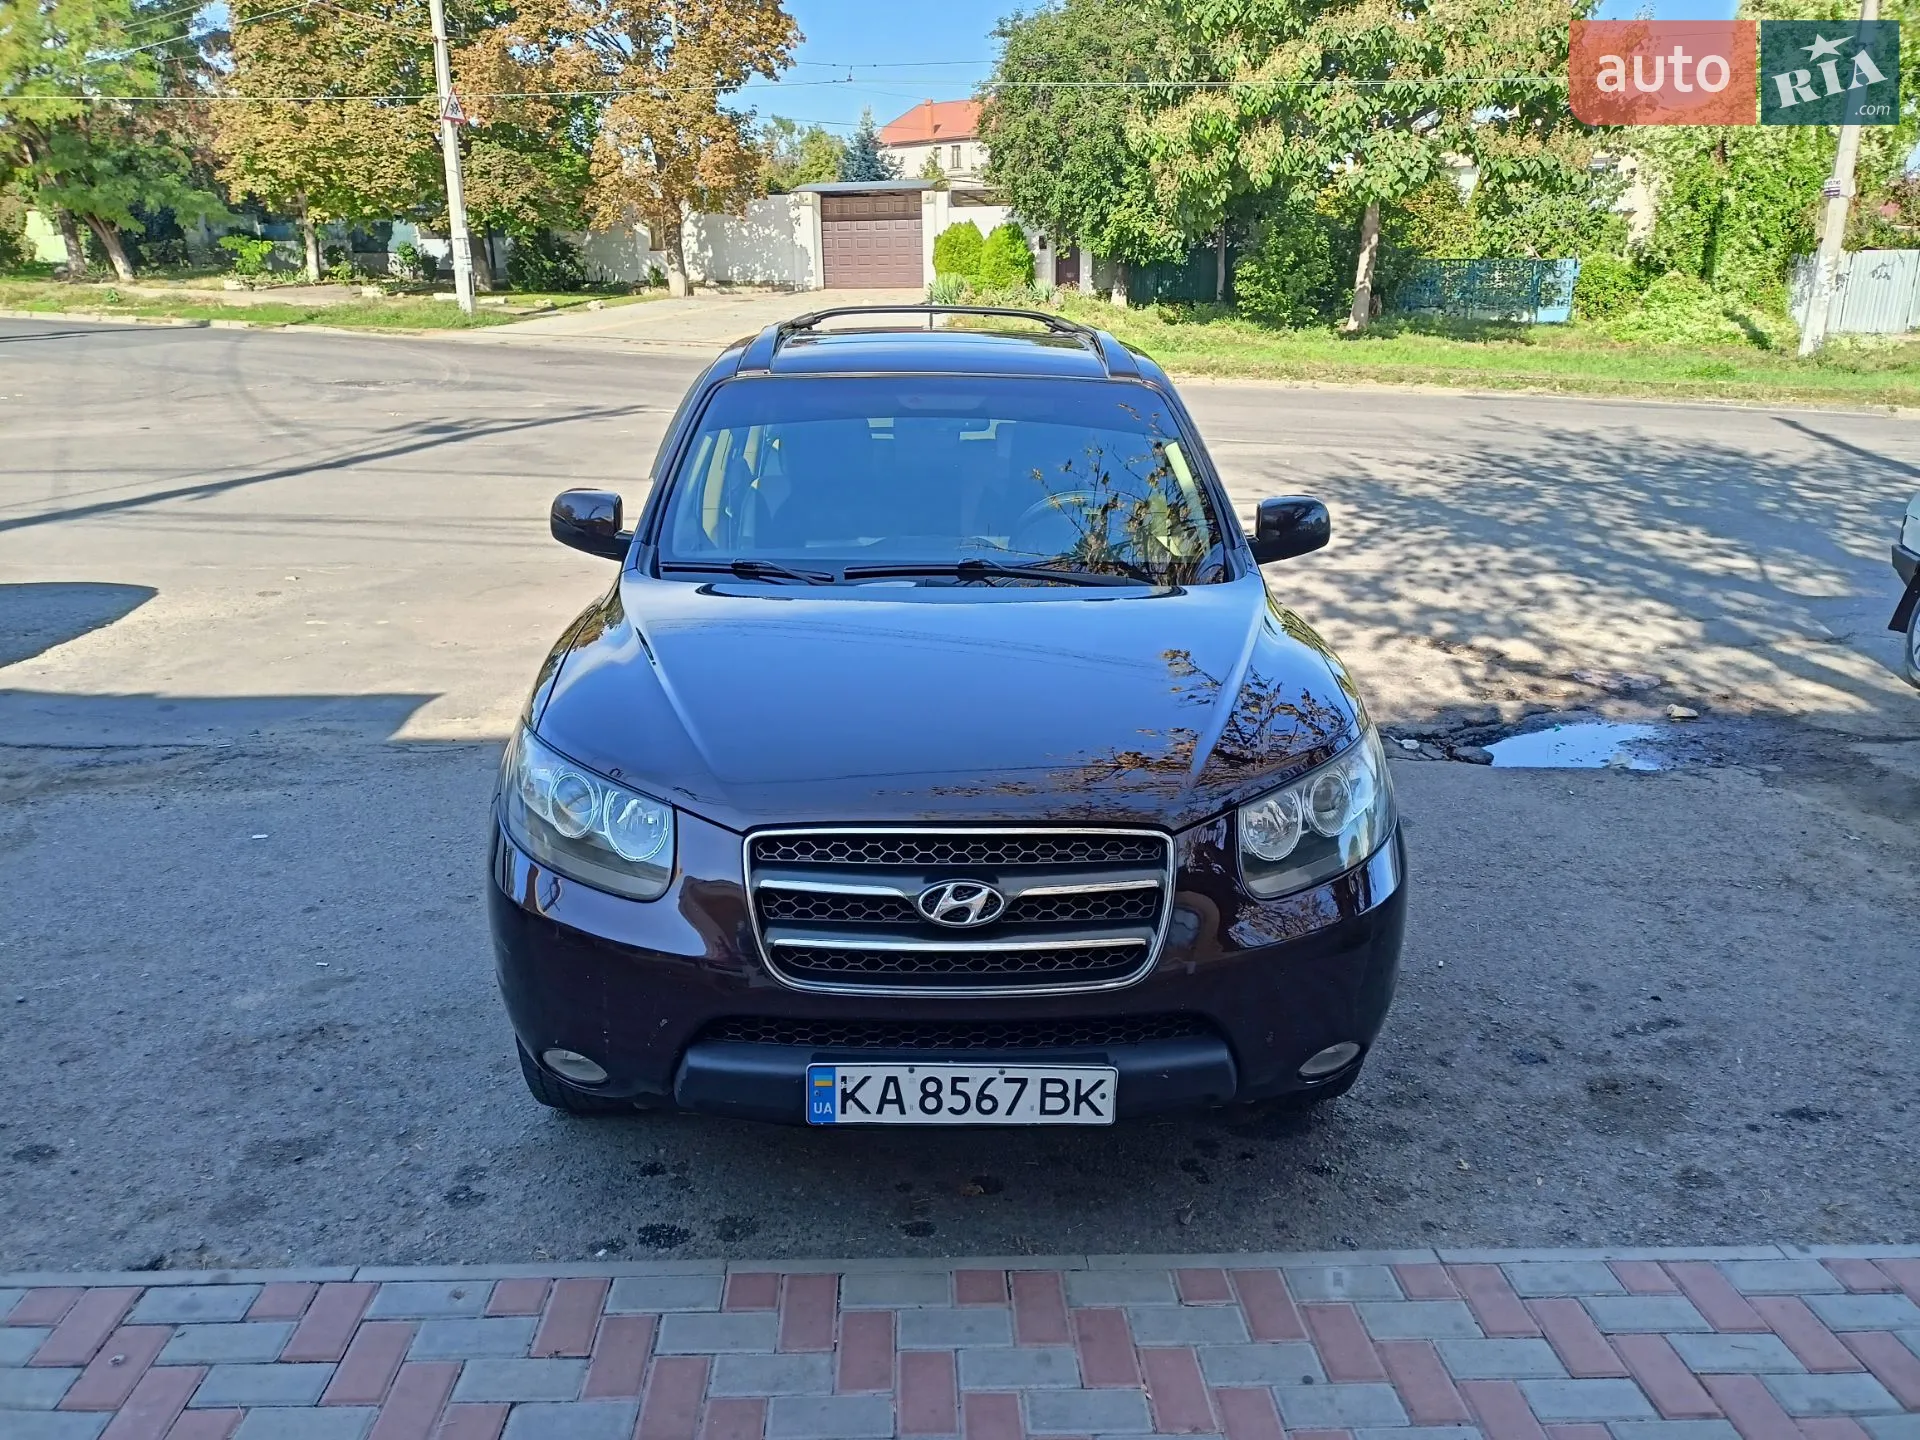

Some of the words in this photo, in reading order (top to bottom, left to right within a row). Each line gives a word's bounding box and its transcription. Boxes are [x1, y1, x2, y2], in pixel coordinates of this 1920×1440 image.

[813, 1101, 833, 1114] UA
[840, 1075, 907, 1115] KA
[918, 1075, 1029, 1116] 8567
[1039, 1077, 1107, 1117] BK
